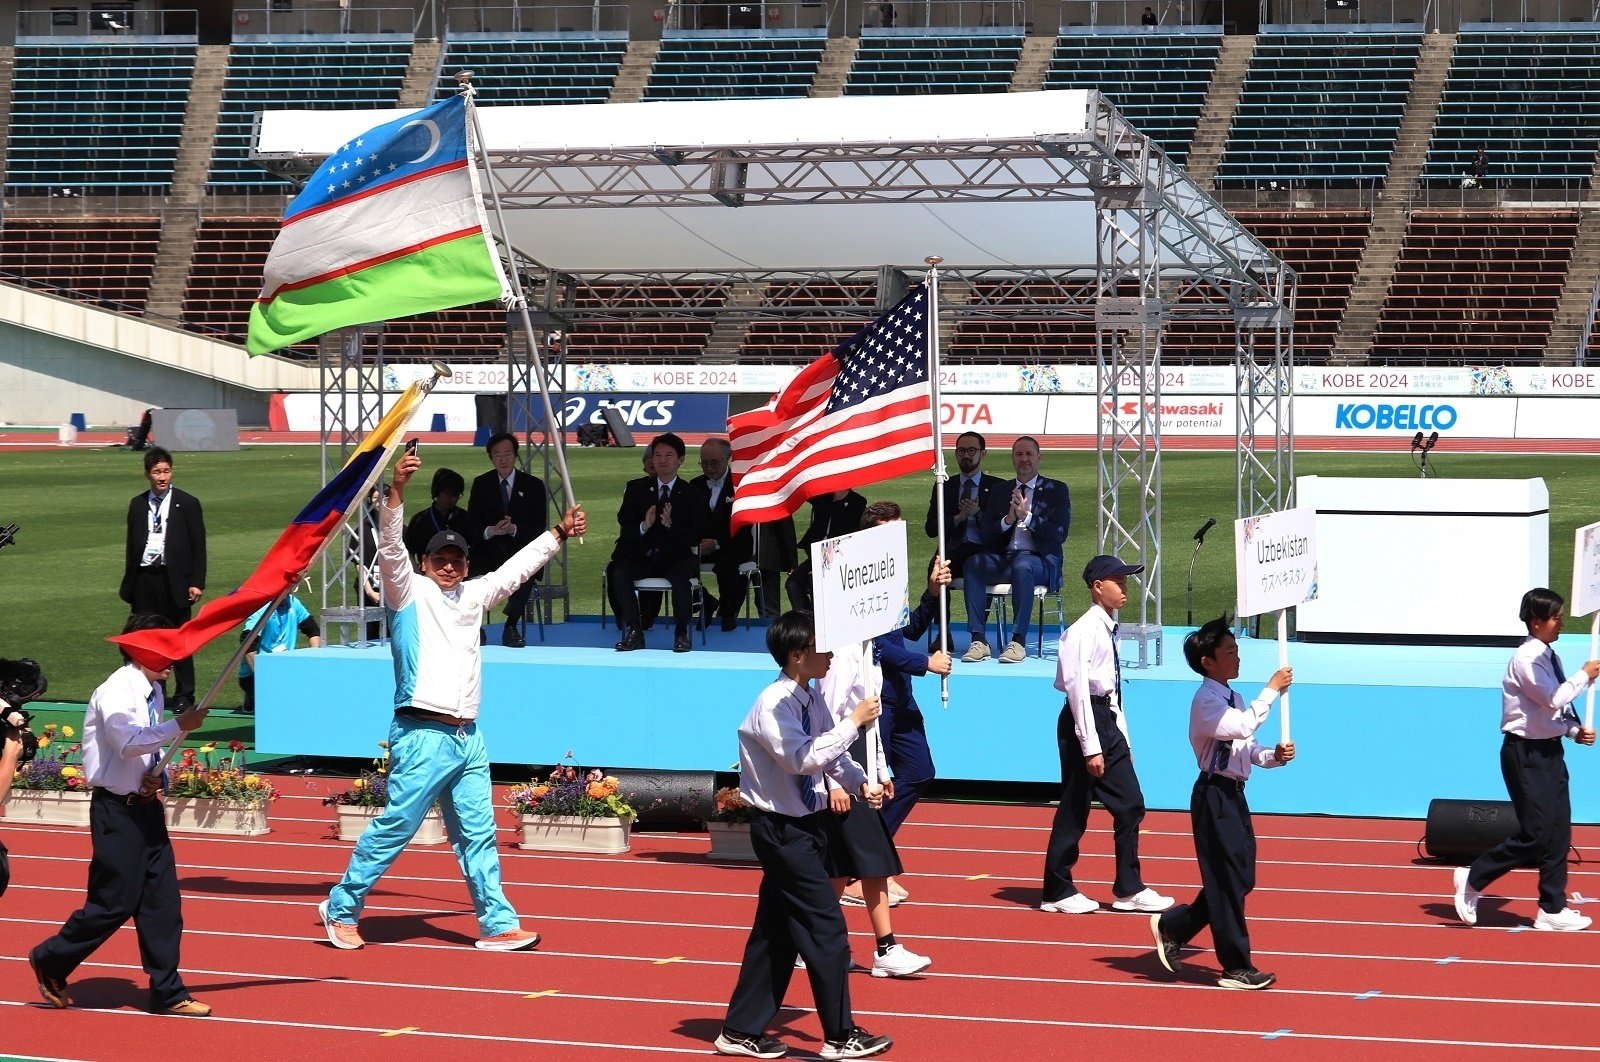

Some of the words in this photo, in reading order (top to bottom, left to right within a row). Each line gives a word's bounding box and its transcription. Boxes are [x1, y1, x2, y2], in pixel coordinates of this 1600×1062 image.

[478, 371, 514, 385] 202
[653, 372, 695, 386] KOBE
[699, 372, 738, 386] 2024
[939, 372, 958, 386] 24
[1322, 373, 1366, 388] KOBE
[1369, 373, 1409, 388] 2024
[1552, 373, 1596, 388] KOBE
[940, 403, 993, 425] OTA
[1144, 402, 1224, 416] Kawasaki
[1176, 418, 1222, 429] potential
[1336, 404, 1458, 430] KOBELCO
[1257, 534, 1309, 565] Uzbekistan
[839, 552, 895, 592] Venezuela
[1261, 567, 1307, 593] ウズベキスタン
[849, 591, 890, 619] ベネズエラ
